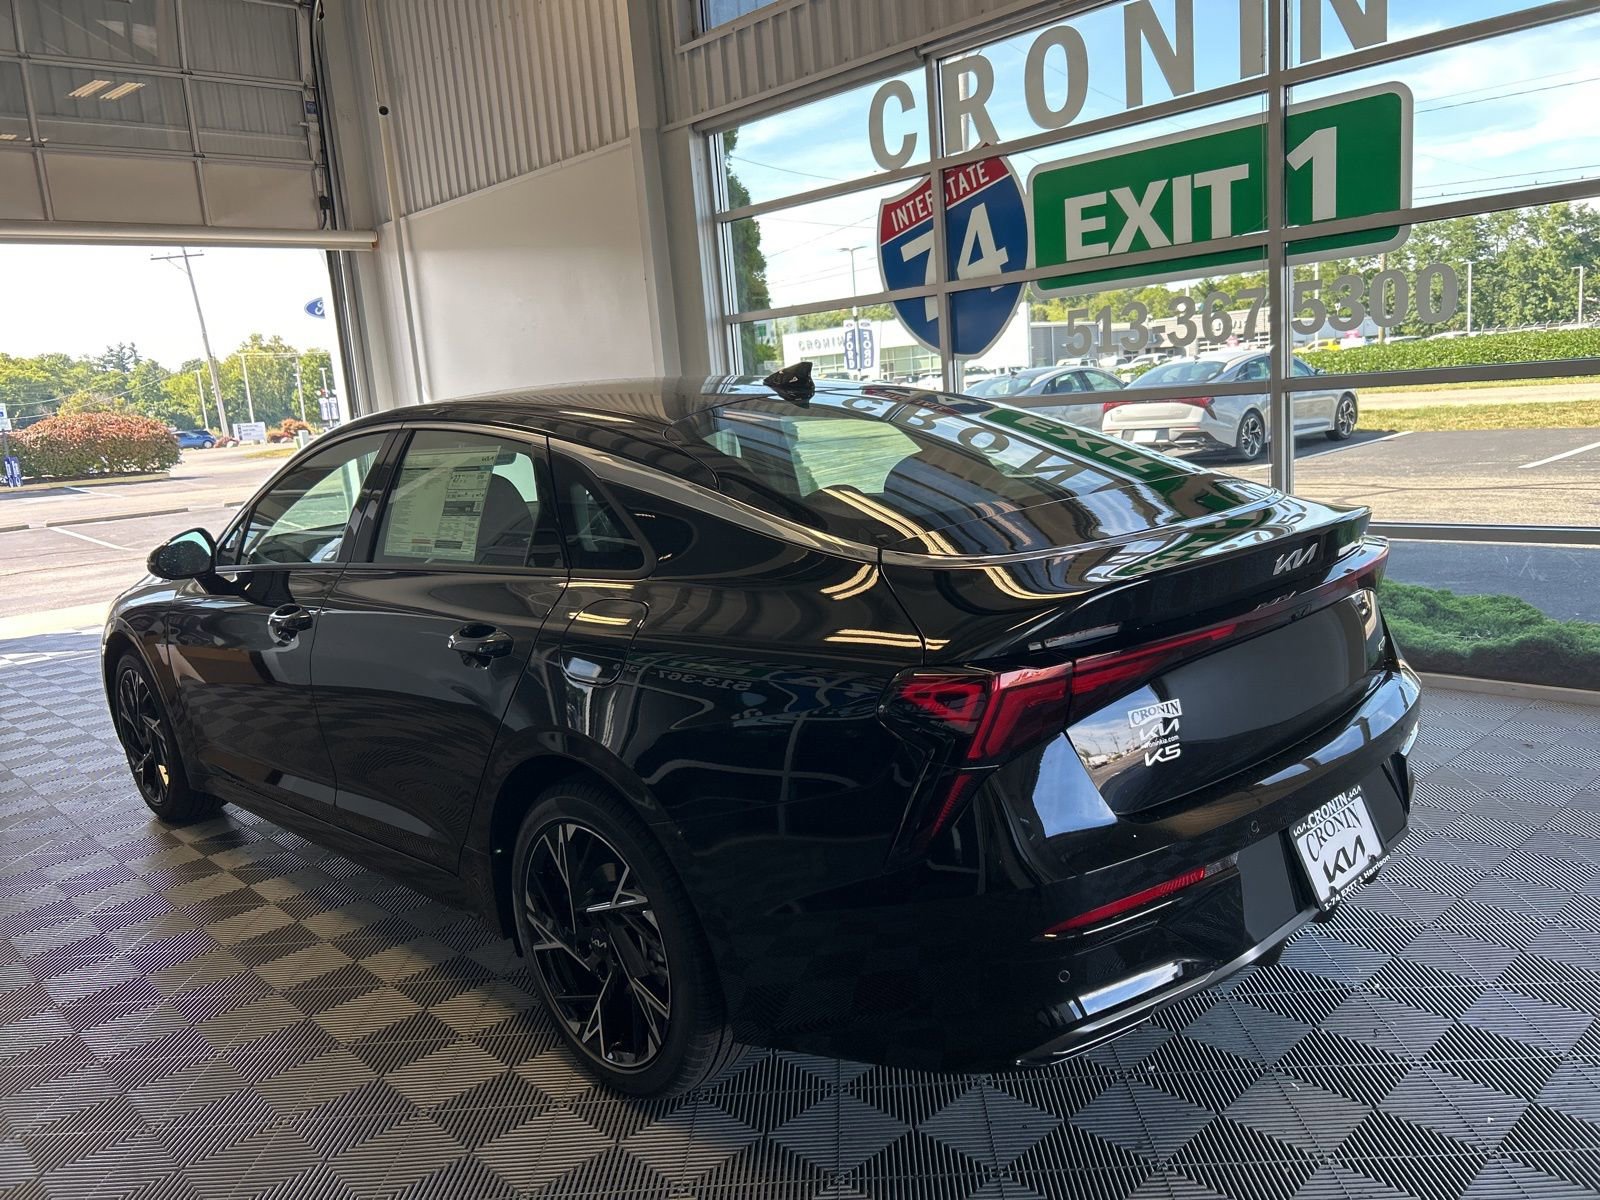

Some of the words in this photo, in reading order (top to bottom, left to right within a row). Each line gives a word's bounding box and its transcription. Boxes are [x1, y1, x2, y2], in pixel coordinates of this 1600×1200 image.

[890, 160, 990, 232] INTERTATE
[1064, 163, 1249, 262] EXIT
[1286, 126, 1338, 222] 1
[900, 203, 1009, 323] 74
[1067, 263, 1458, 356] 513-3675300
[846, 331, 855, 369] FORD
[1131, 701, 1179, 725] CRONIN
[1144, 743, 1181, 767] K5
[1306, 803, 1362, 862] CRONIN
[1324, 895, 1340, 911] I-74
[1341, 882, 1357, 896] EXIT
[1364, 854, 1391, 878] Harrison
